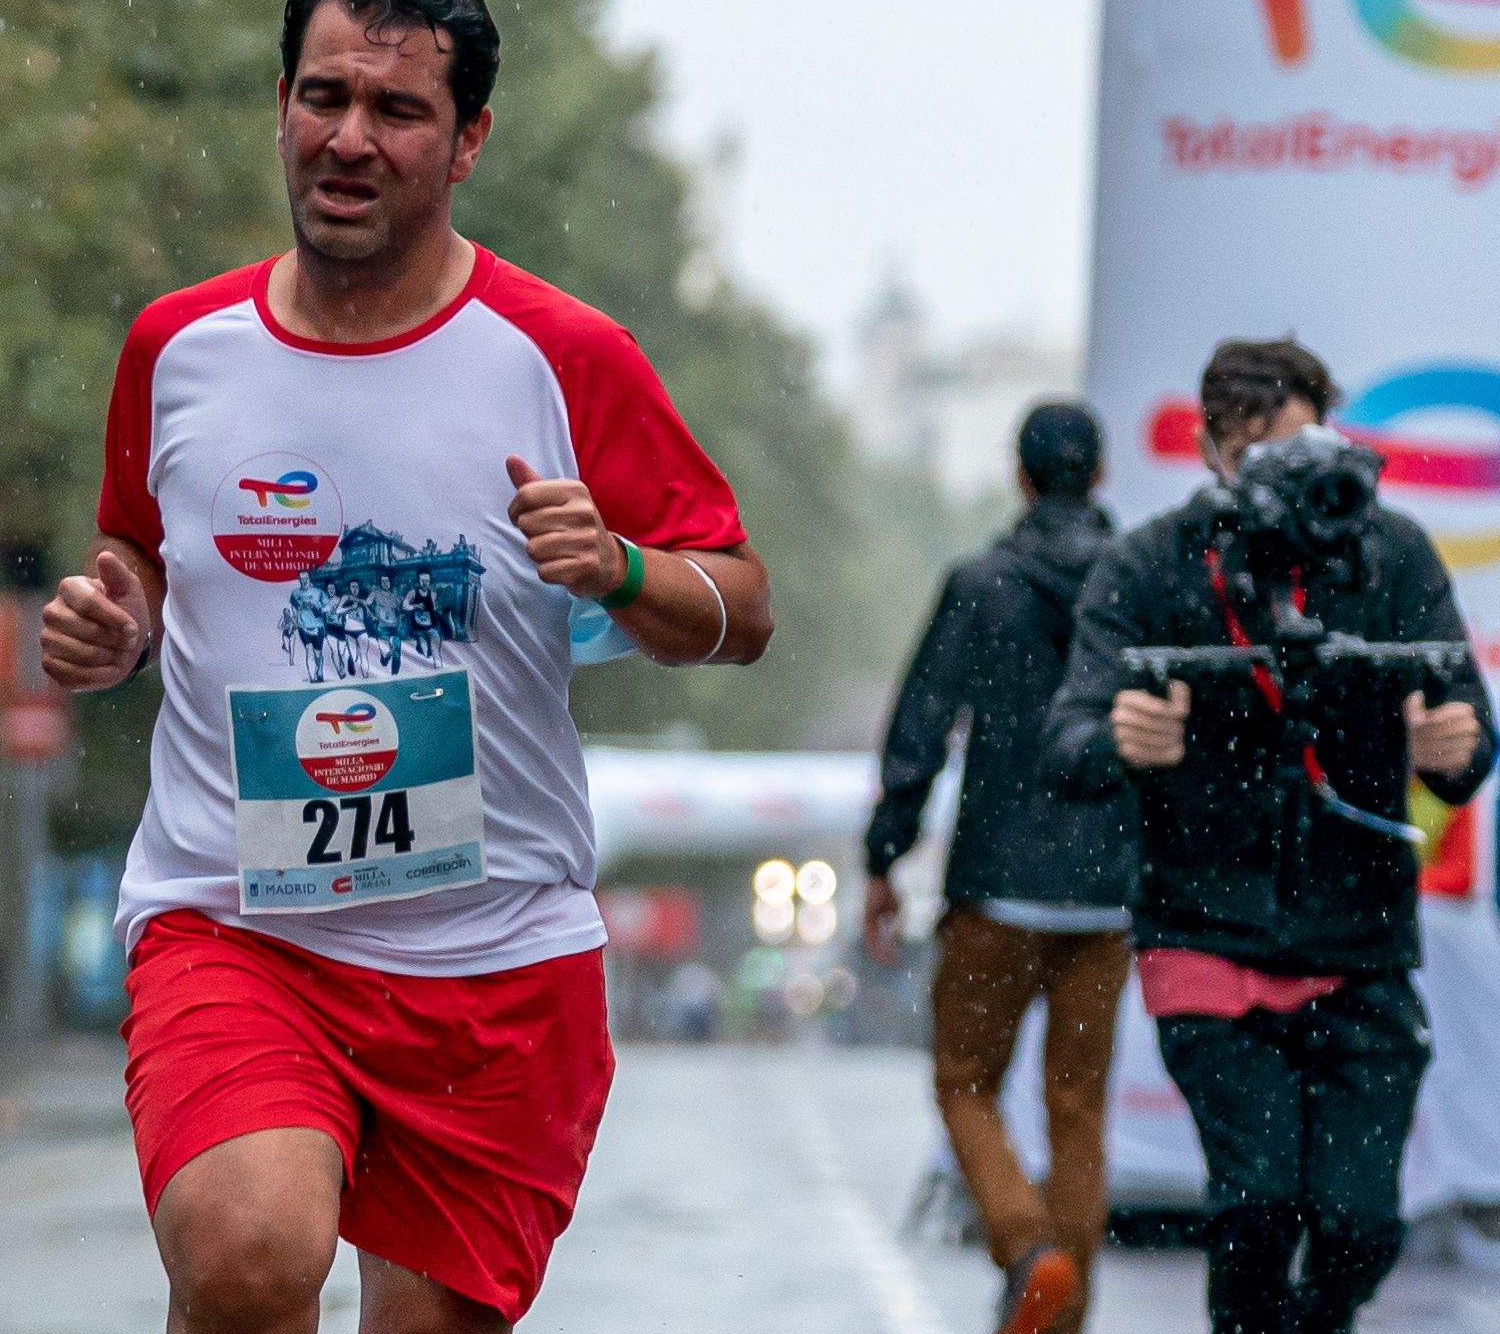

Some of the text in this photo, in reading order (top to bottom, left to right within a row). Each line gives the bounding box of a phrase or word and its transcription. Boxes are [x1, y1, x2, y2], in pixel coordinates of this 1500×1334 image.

[237, 514, 317, 527] TotalEnergies
[318, 737, 380, 750] TotalEnergies
[302, 789, 415, 866] 274
[265, 882, 317, 896] MADRID
